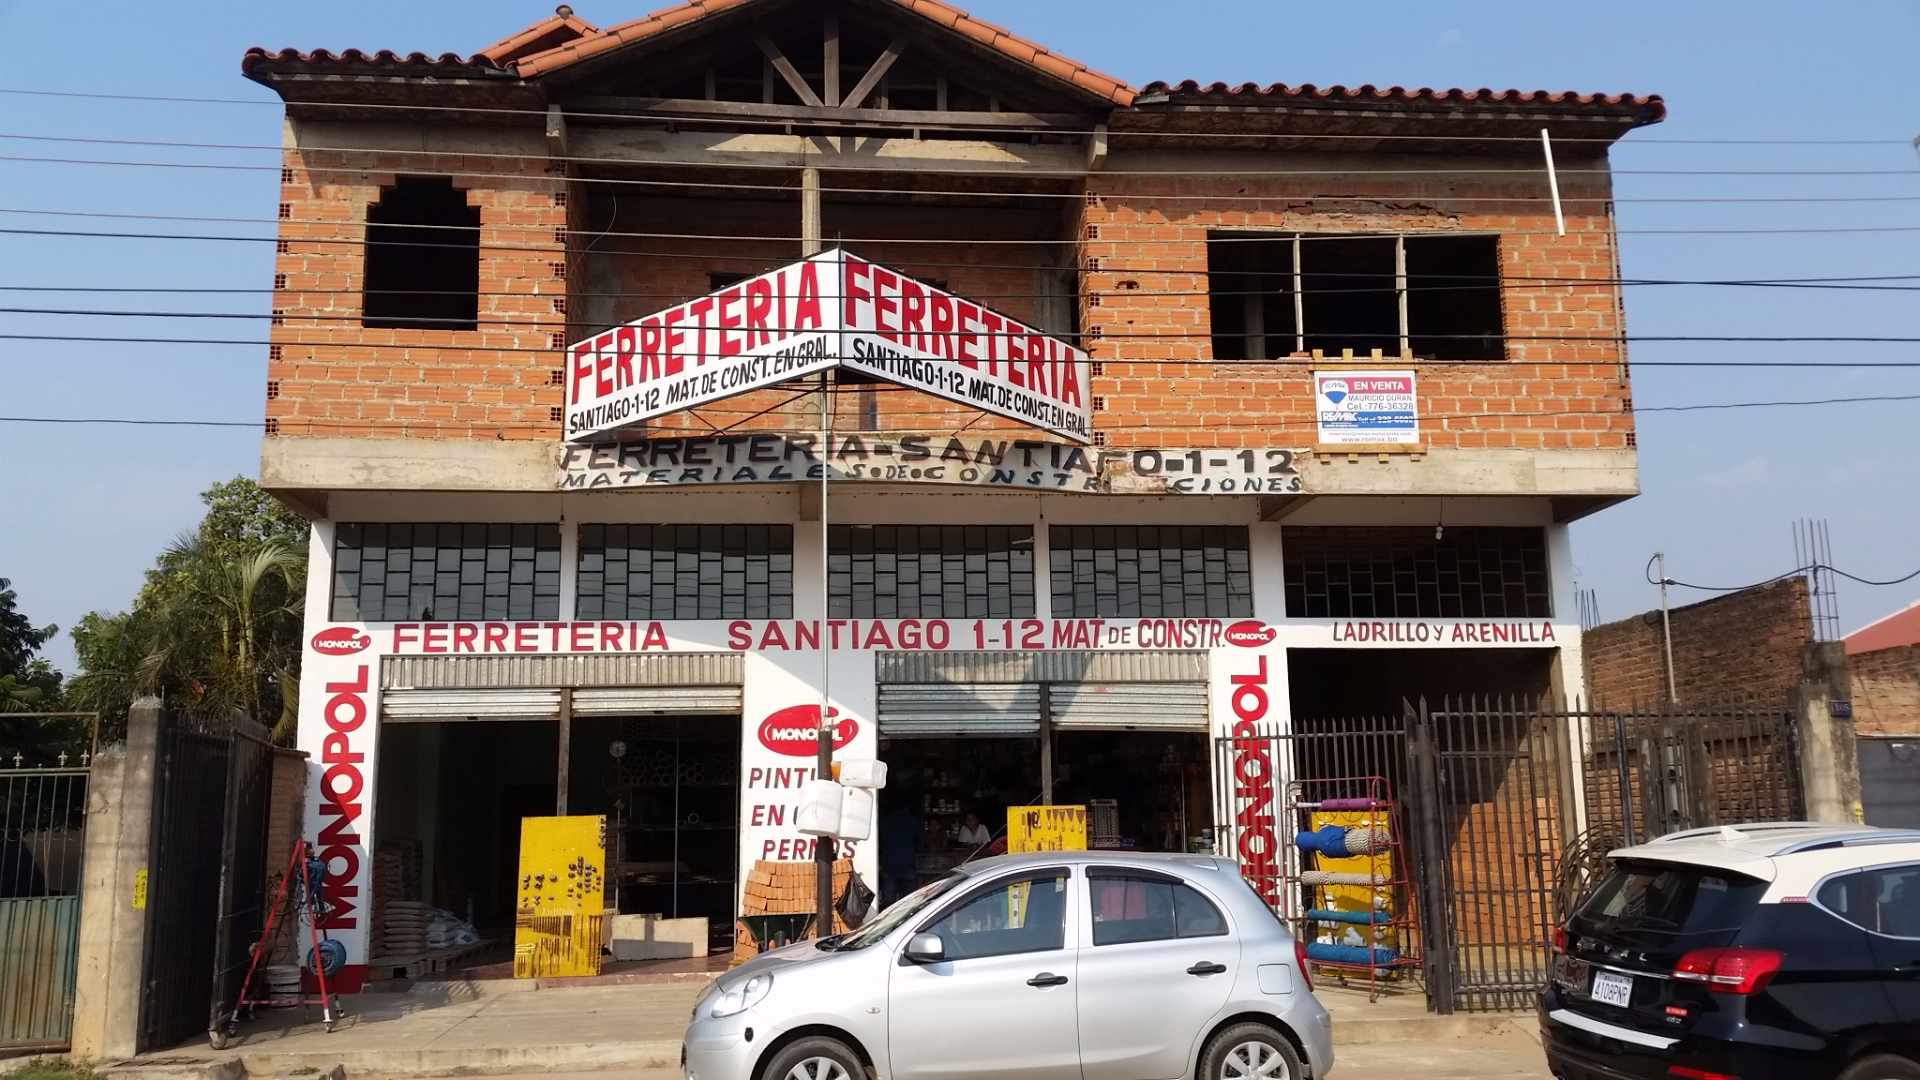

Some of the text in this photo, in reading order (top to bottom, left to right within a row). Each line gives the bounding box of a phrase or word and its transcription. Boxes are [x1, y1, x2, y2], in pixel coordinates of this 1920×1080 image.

[570, 260, 823, 406] FERRETERIA
[844, 254, 1082, 409] FERRETERIA
[1353, 381, 1406, 391] EN VENTA
[318, 639, 363, 650] MONOPOL
[392, 618, 1226, 653] FERRETERIA SANTIAGO 1-12 MAT. DE CONSTR.
[1230, 631, 1271, 641] MONOPOL
[1332, 621, 1429, 642] LADRILLO
[1451, 621, 1556, 643] ARENILLA
[1230, 654, 1281, 906] MONOPOL
[315, 664, 369, 930] MONOPOL
[750, 804, 786, 827] EN
